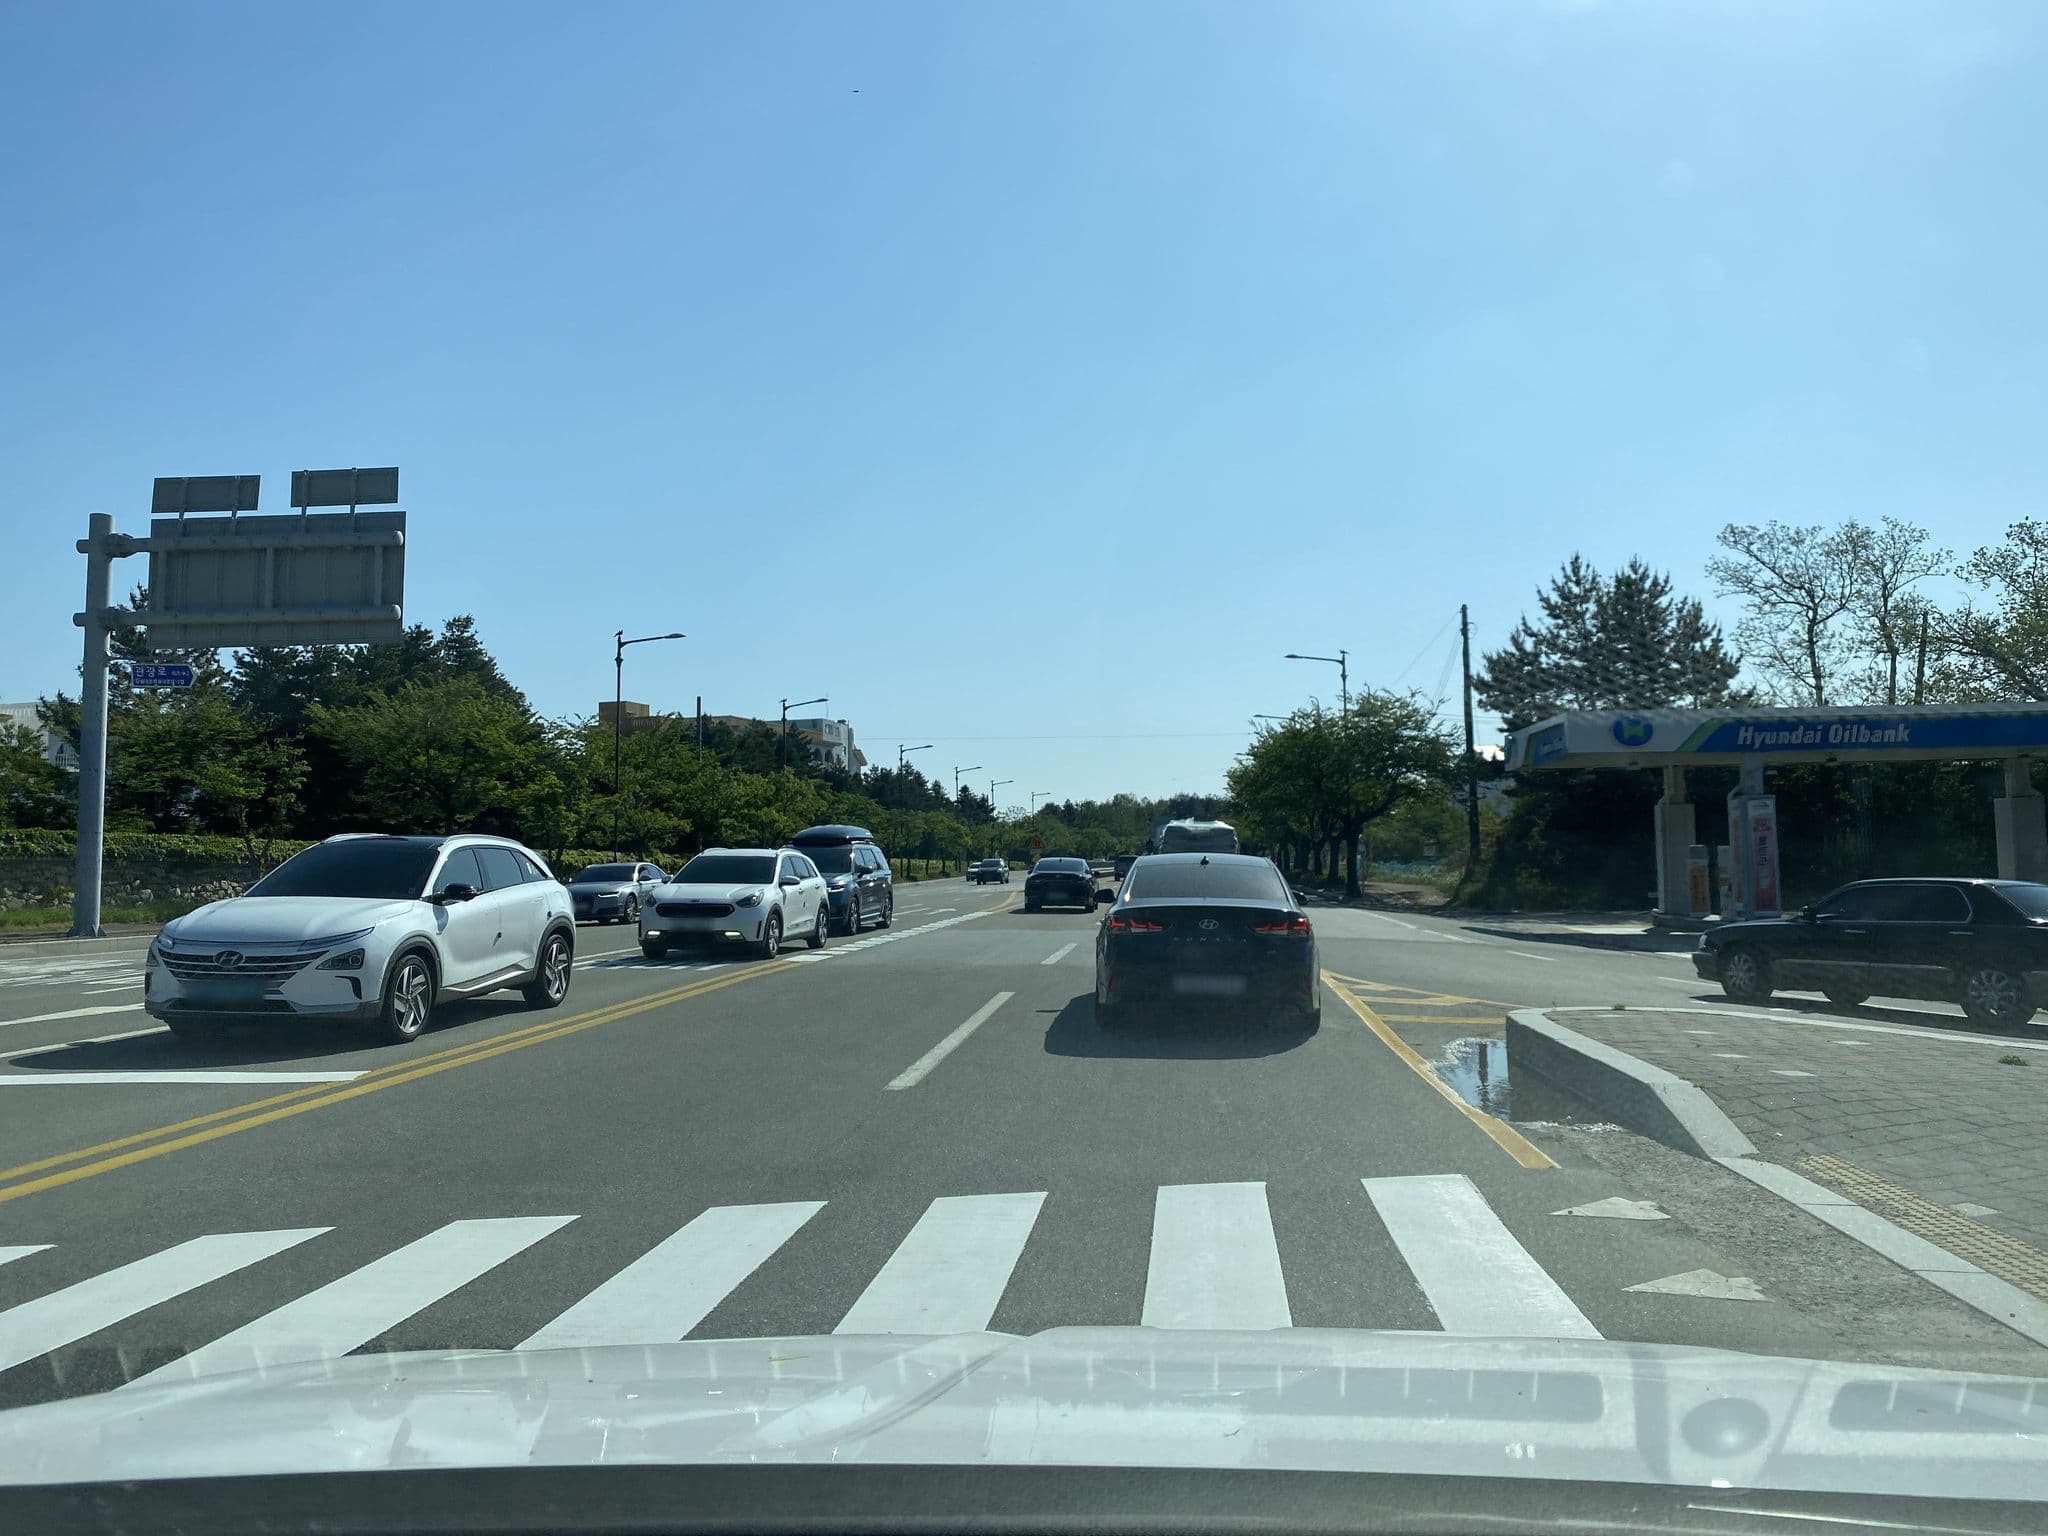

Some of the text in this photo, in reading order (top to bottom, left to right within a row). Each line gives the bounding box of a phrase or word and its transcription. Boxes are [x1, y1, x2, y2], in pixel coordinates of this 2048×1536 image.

[135, 666, 167, 678] 관광로
[1737, 723, 1911, 749] Hyundai Oilbank
